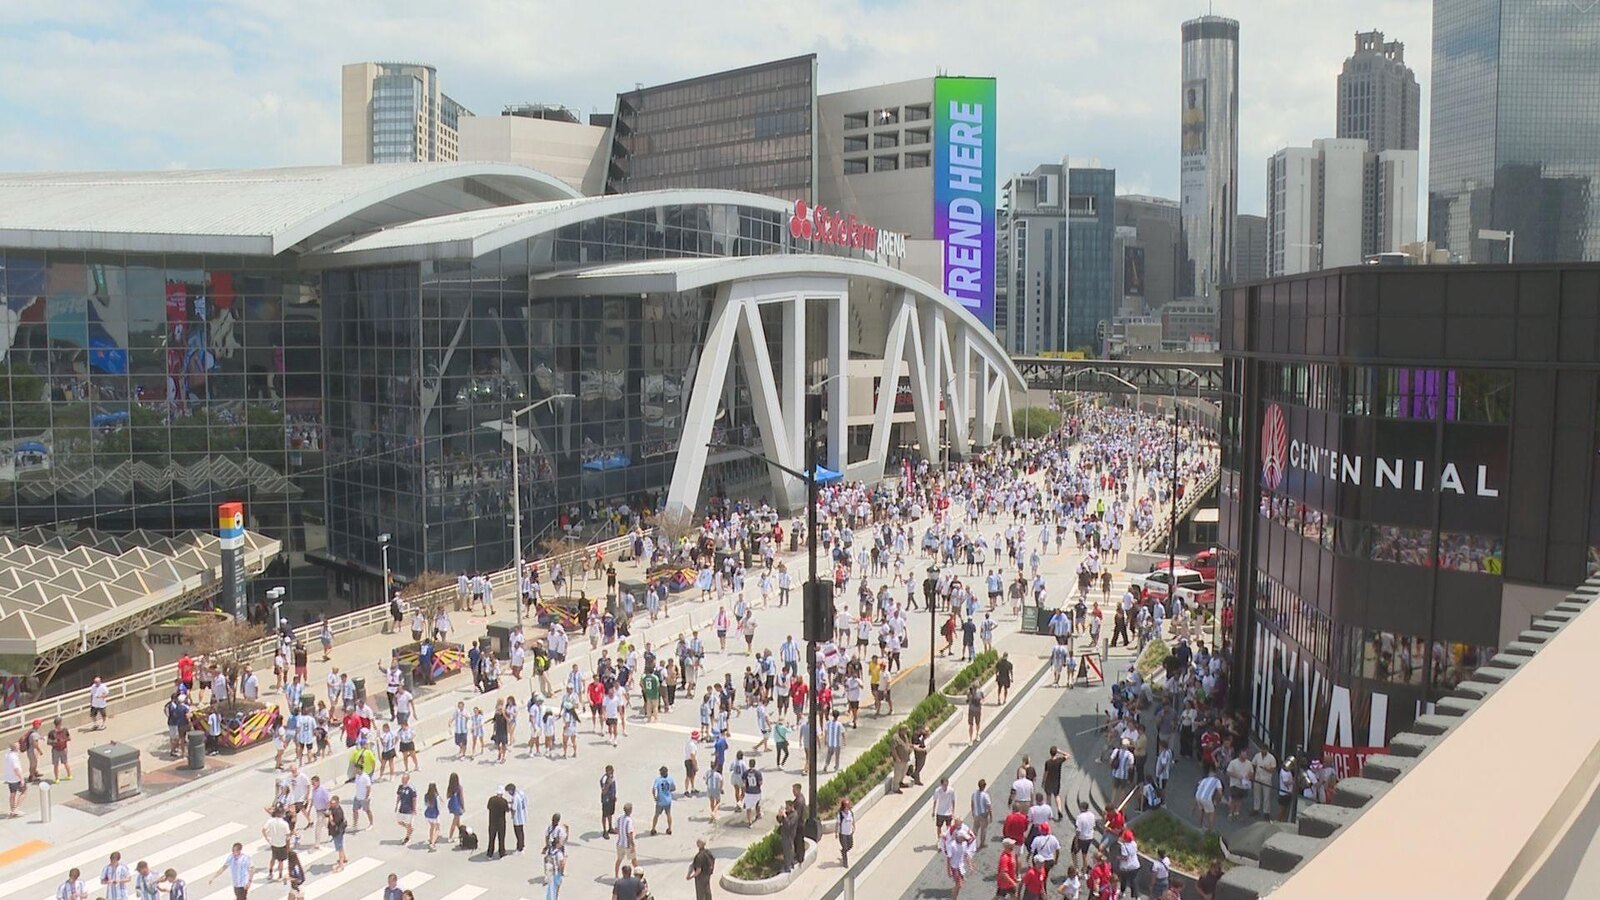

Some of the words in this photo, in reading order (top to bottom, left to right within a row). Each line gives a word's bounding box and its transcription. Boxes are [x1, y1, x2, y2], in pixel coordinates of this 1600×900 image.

[949, 100, 982, 192] HERE
[813, 205, 847, 247] State
[847, 212, 877, 251] Farm
[877, 229, 906, 258] ARENA
[947, 197, 982, 308] TREND
[1289, 439, 1499, 497] CENTENNIAL
[646, 680, 653, 690] 13
[661, 782, 670, 793] 10
[748, 776, 757, 787] 10
